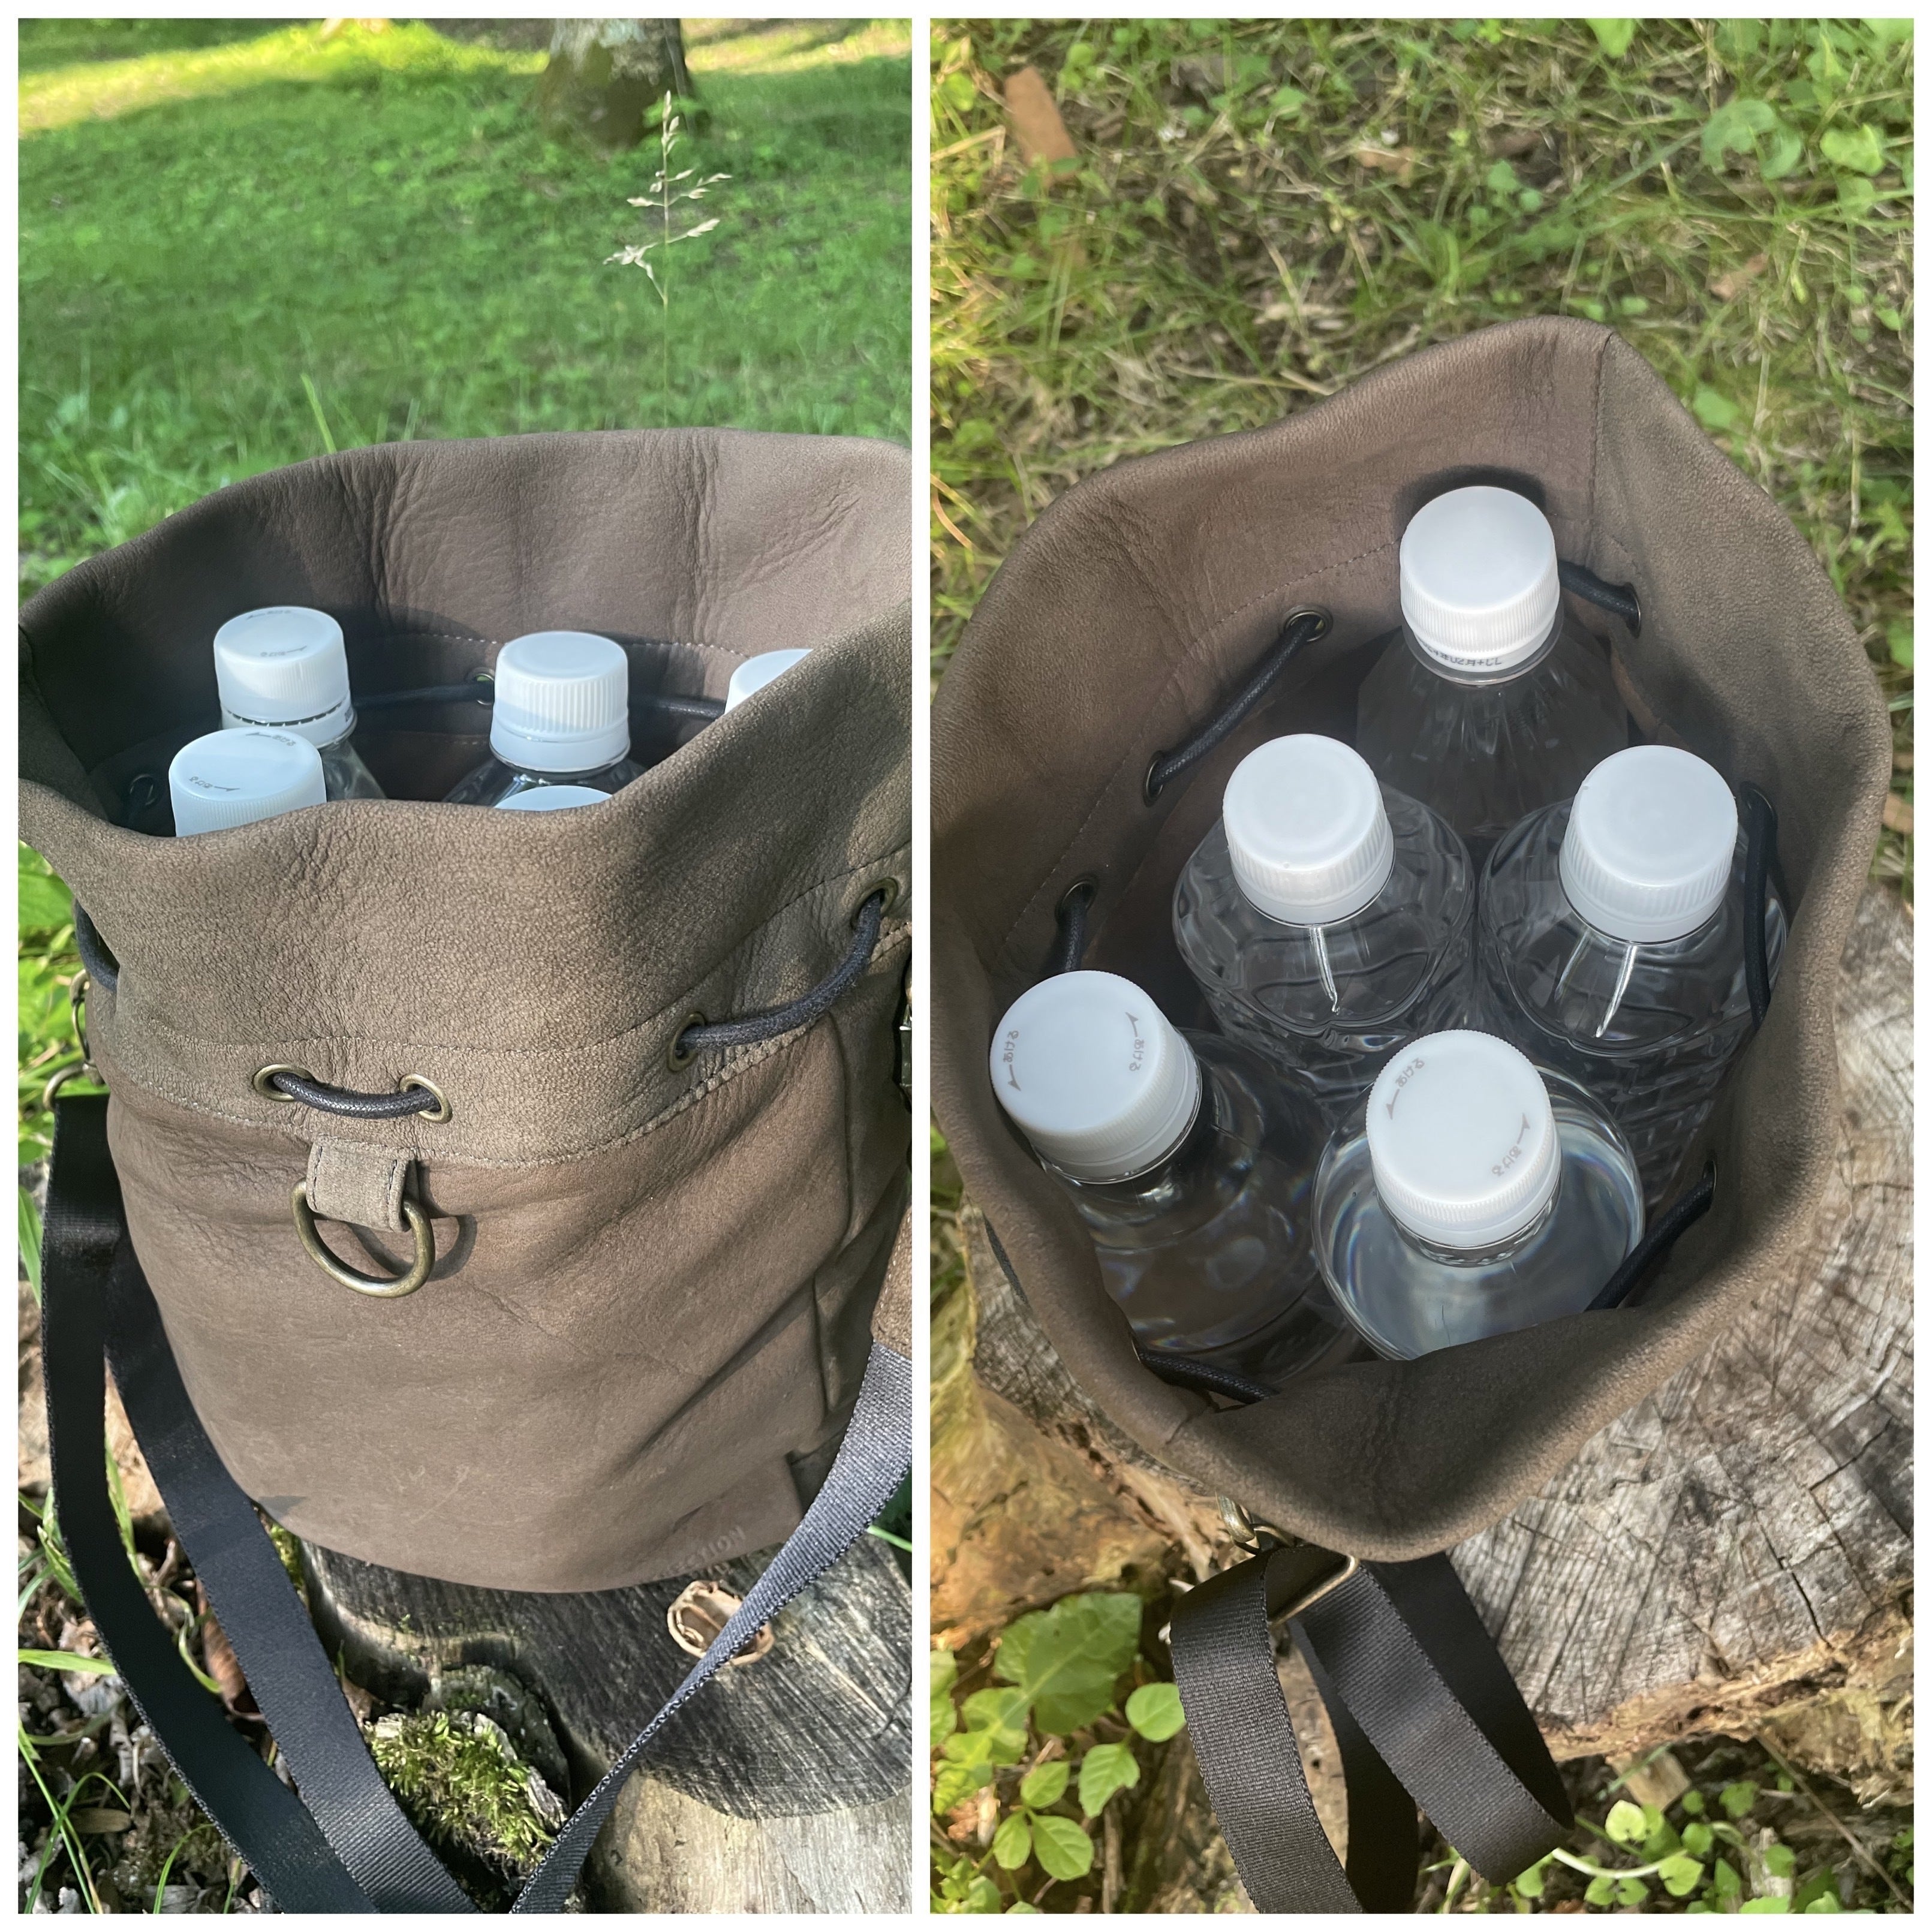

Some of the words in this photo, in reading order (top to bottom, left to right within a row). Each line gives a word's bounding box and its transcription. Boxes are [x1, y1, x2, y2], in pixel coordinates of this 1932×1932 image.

[1003, 1030, 1019, 1063] あける
[1128, 1038, 1145, 1072] あける
[1395, 1057, 1426, 1088] あける
[1491, 1145, 1522, 1177] あける
